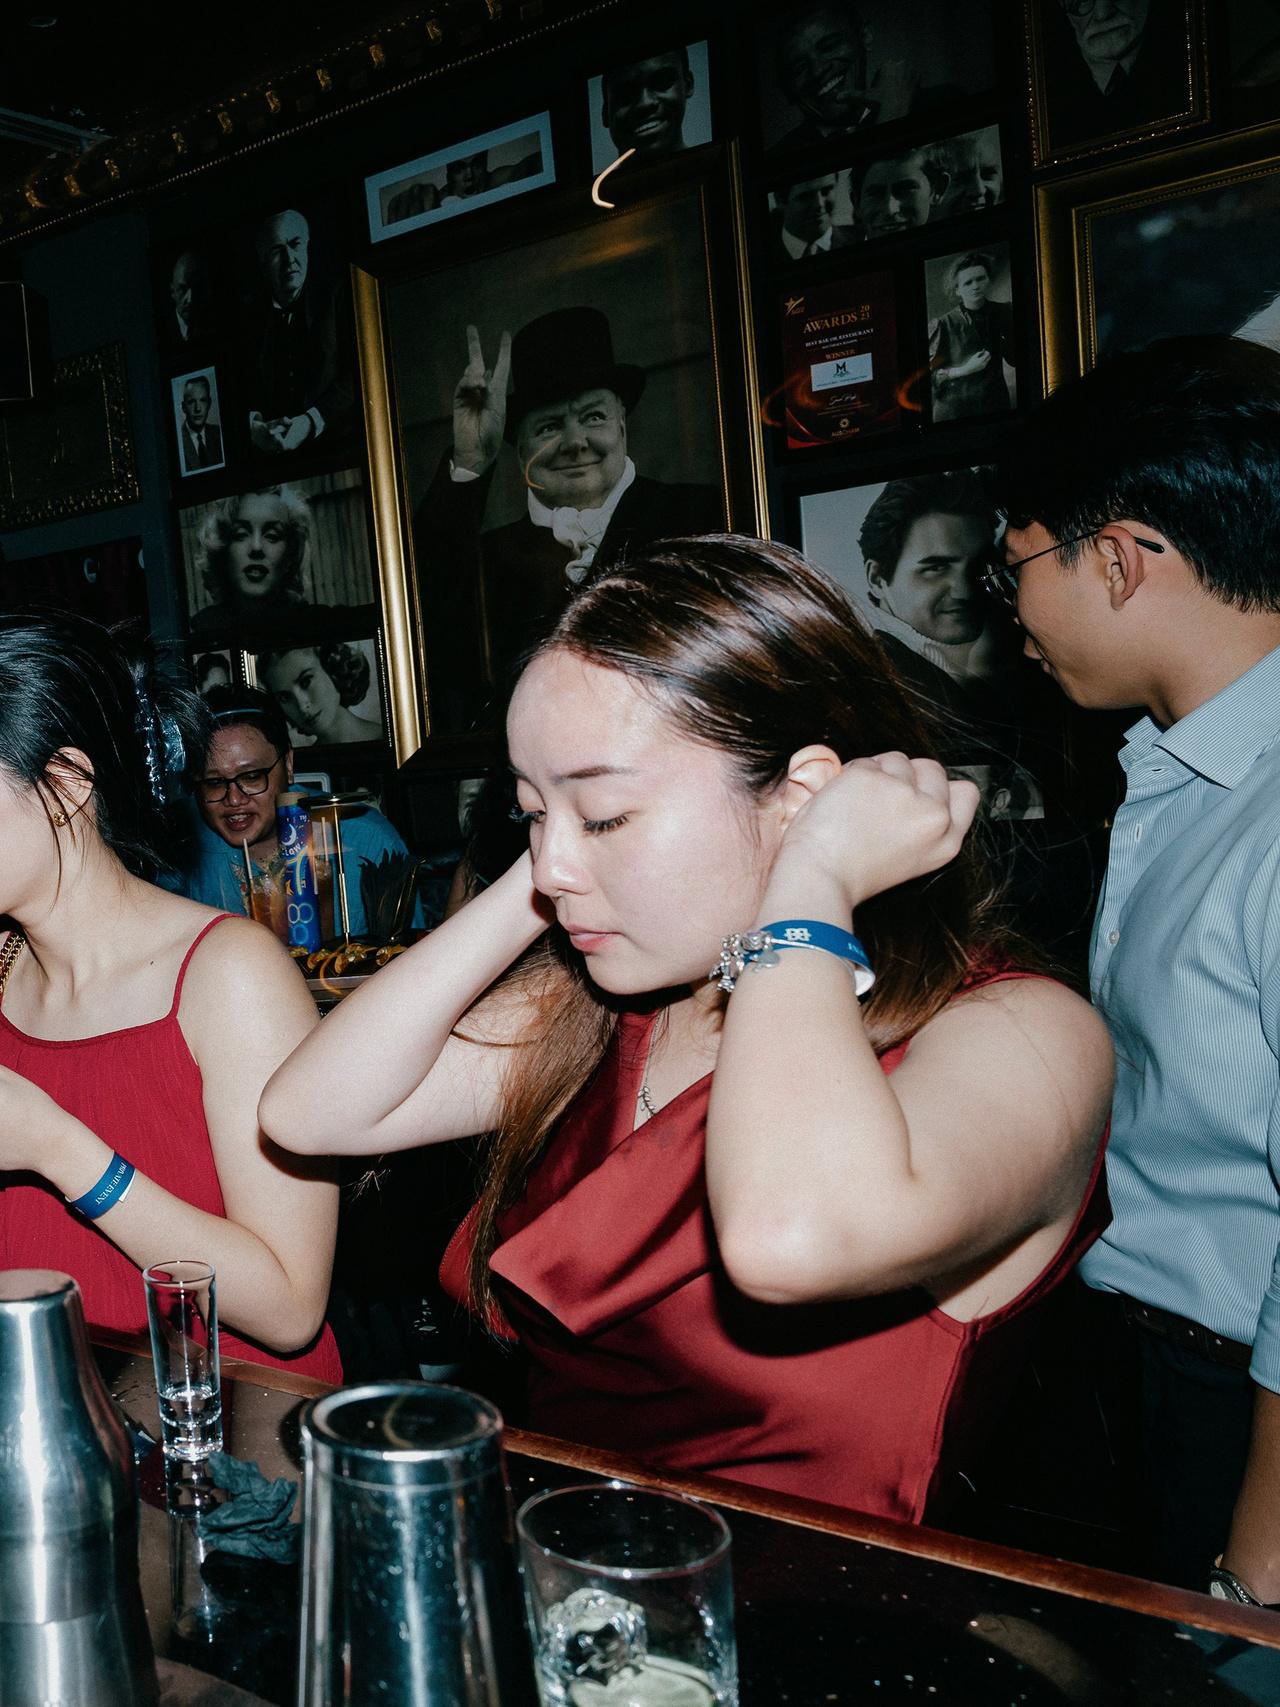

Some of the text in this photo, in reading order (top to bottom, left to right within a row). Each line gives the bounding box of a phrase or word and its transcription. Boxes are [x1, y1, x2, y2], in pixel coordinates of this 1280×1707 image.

[803, 312, 858, 333] AWARDS
[805, 340, 817, 348] BEST
[825, 349, 856, 360] WINNER
[836, 362, 846, 374] M
[95, 1162, 126, 1205] PRIVATE EVENT
